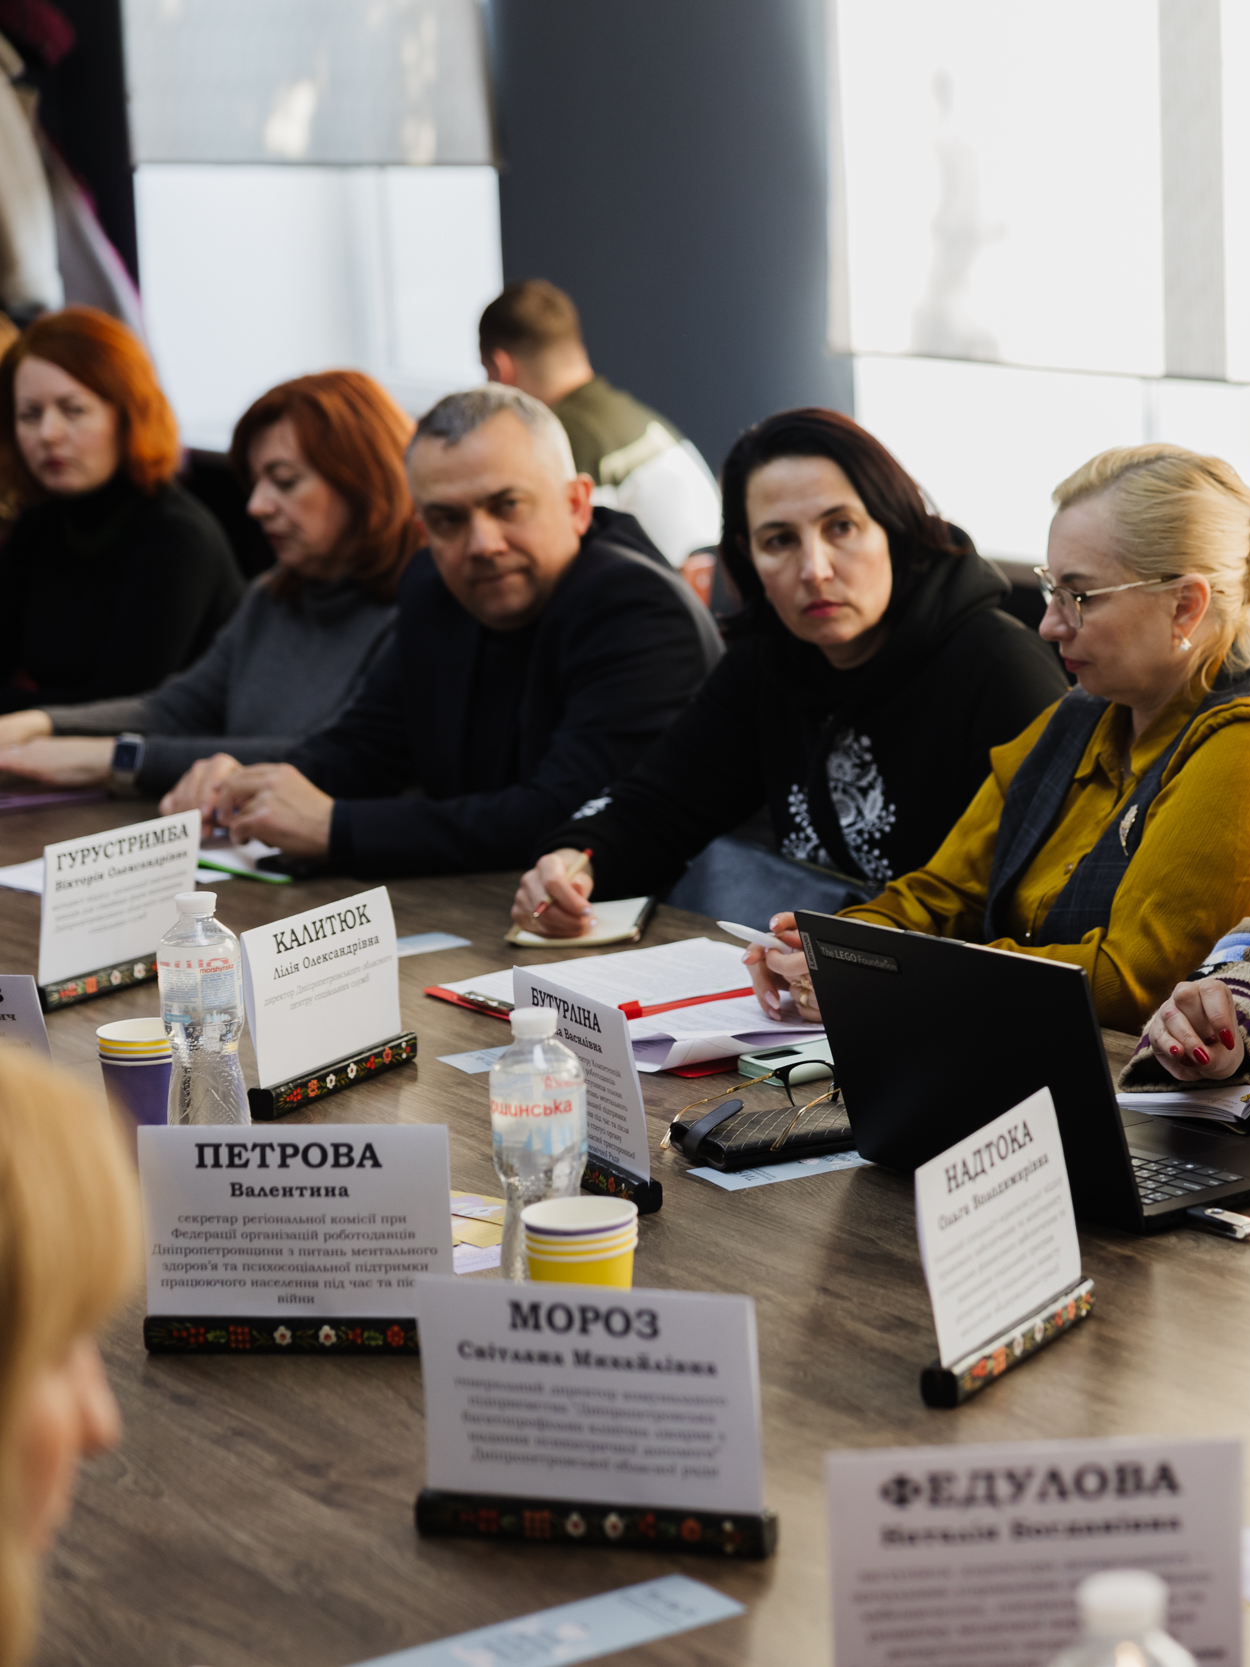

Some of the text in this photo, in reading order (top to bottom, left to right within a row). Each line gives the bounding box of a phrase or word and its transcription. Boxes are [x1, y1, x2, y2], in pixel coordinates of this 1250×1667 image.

[57, 824, 188, 871] ГУРУСТРИМБА
[272, 904, 371, 954] КАЛИТЮК
[273, 935, 380, 980] Лілія Олександрівна
[821, 947, 898, 972] The LEGO Foundation
[531, 987, 602, 1033] БУТУРЛІНА
[564, 1028, 603, 1054] Василівна
[195, 1142, 383, 1169] ПЕТРОВА
[945, 1119, 1034, 1194] НАДТОКА
[229, 1182, 350, 1198] Валентина
[178, 1213, 407, 1227] секретар регіональної комісії при
[171, 1228, 416, 1243] Федерації організацій роботодавців
[152, 1243, 283, 1258] Дніпропетровщини
[351, 1247, 438, 1256] ментального
[222, 1263, 238, 1271] та
[242, 1262, 351, 1273] психосоціальної
[355, 1262, 429, 1274] підтримки
[161, 1277, 417, 1290] працюючого населення під час та піс
[277, 1293, 315, 1304] війни
[508, 1300, 661, 1341] МОРОЗ
[457, 1339, 719, 1378] Світлана Михайлівна
[880, 1460, 1182, 1510] ФЕДУЛОВА
